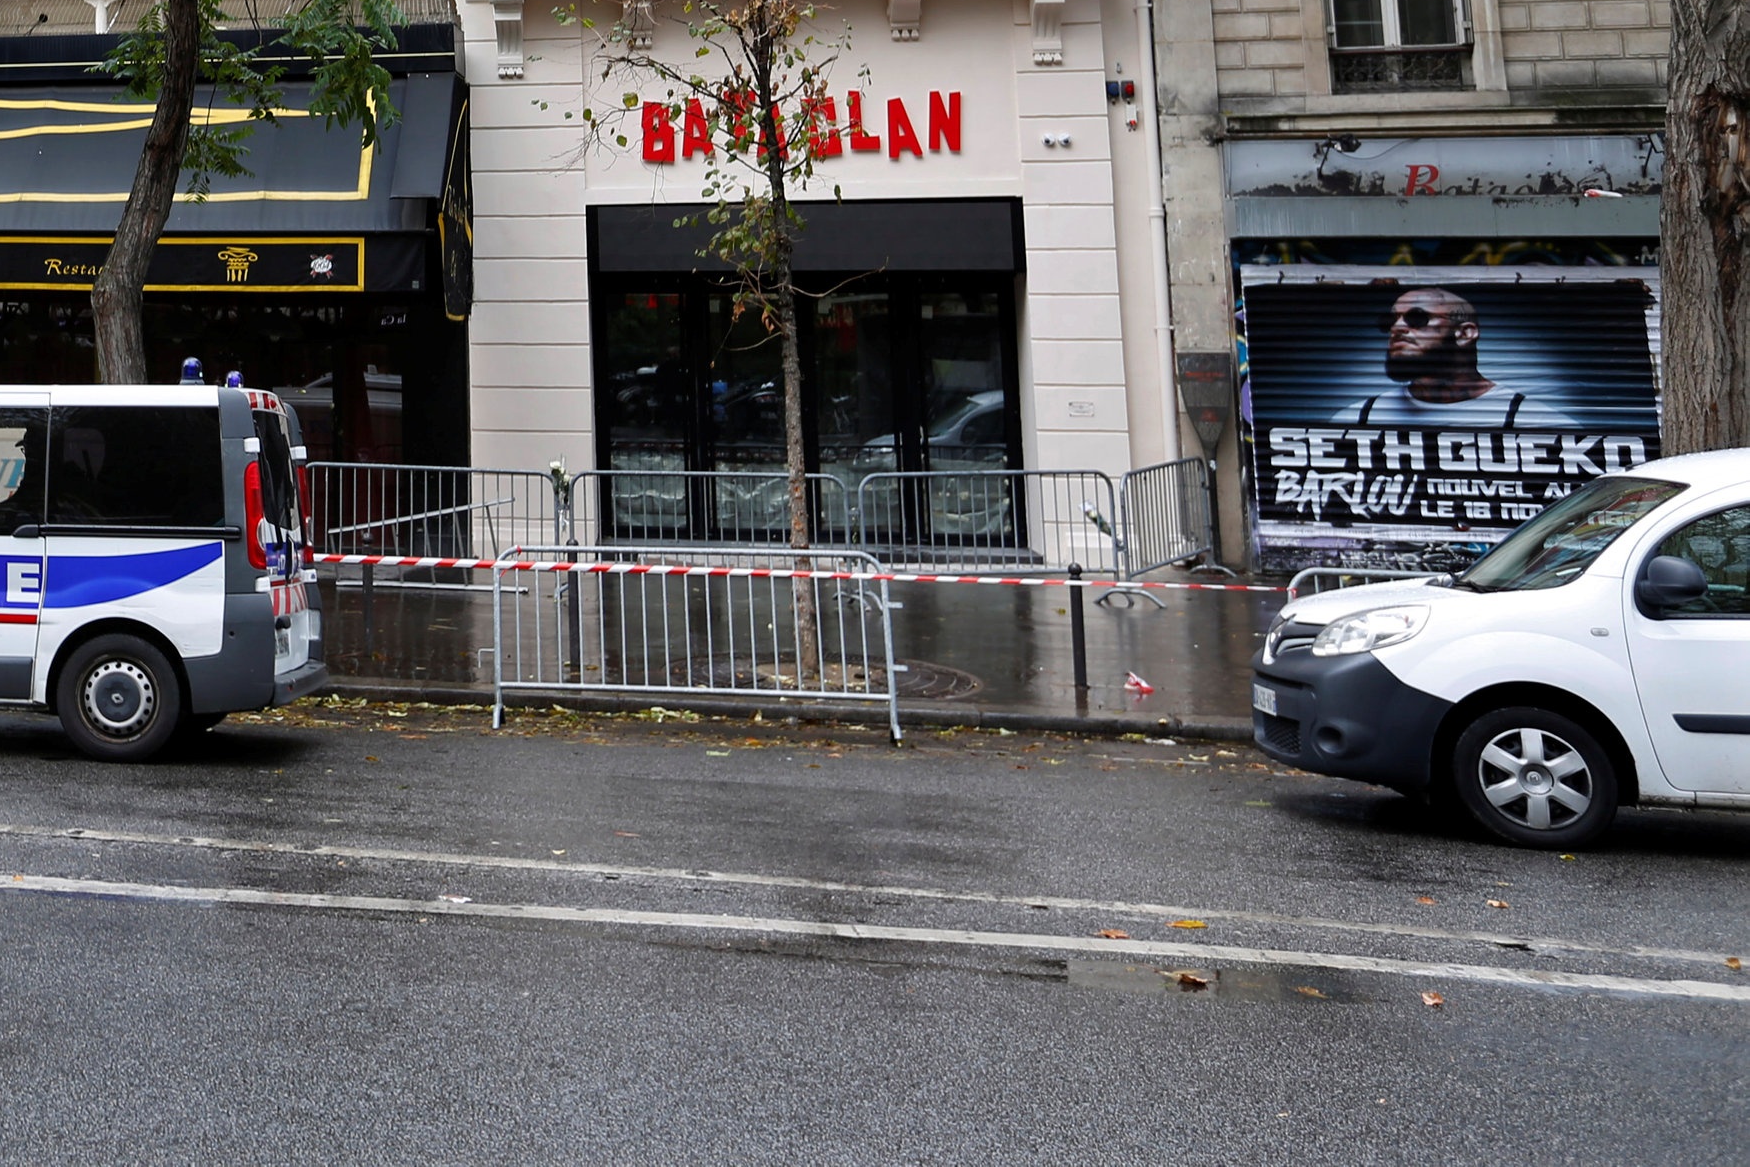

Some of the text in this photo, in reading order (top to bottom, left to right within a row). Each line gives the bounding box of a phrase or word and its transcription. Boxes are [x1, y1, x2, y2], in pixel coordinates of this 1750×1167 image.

[44, 258, 104, 276] Resta
[1269, 427, 1646, 476] SETH GUEKO
[1426, 478, 1533, 499] NOUVEL
[1420, 500, 1456, 518] LE
[1463, 501, 1492, 520] 18
